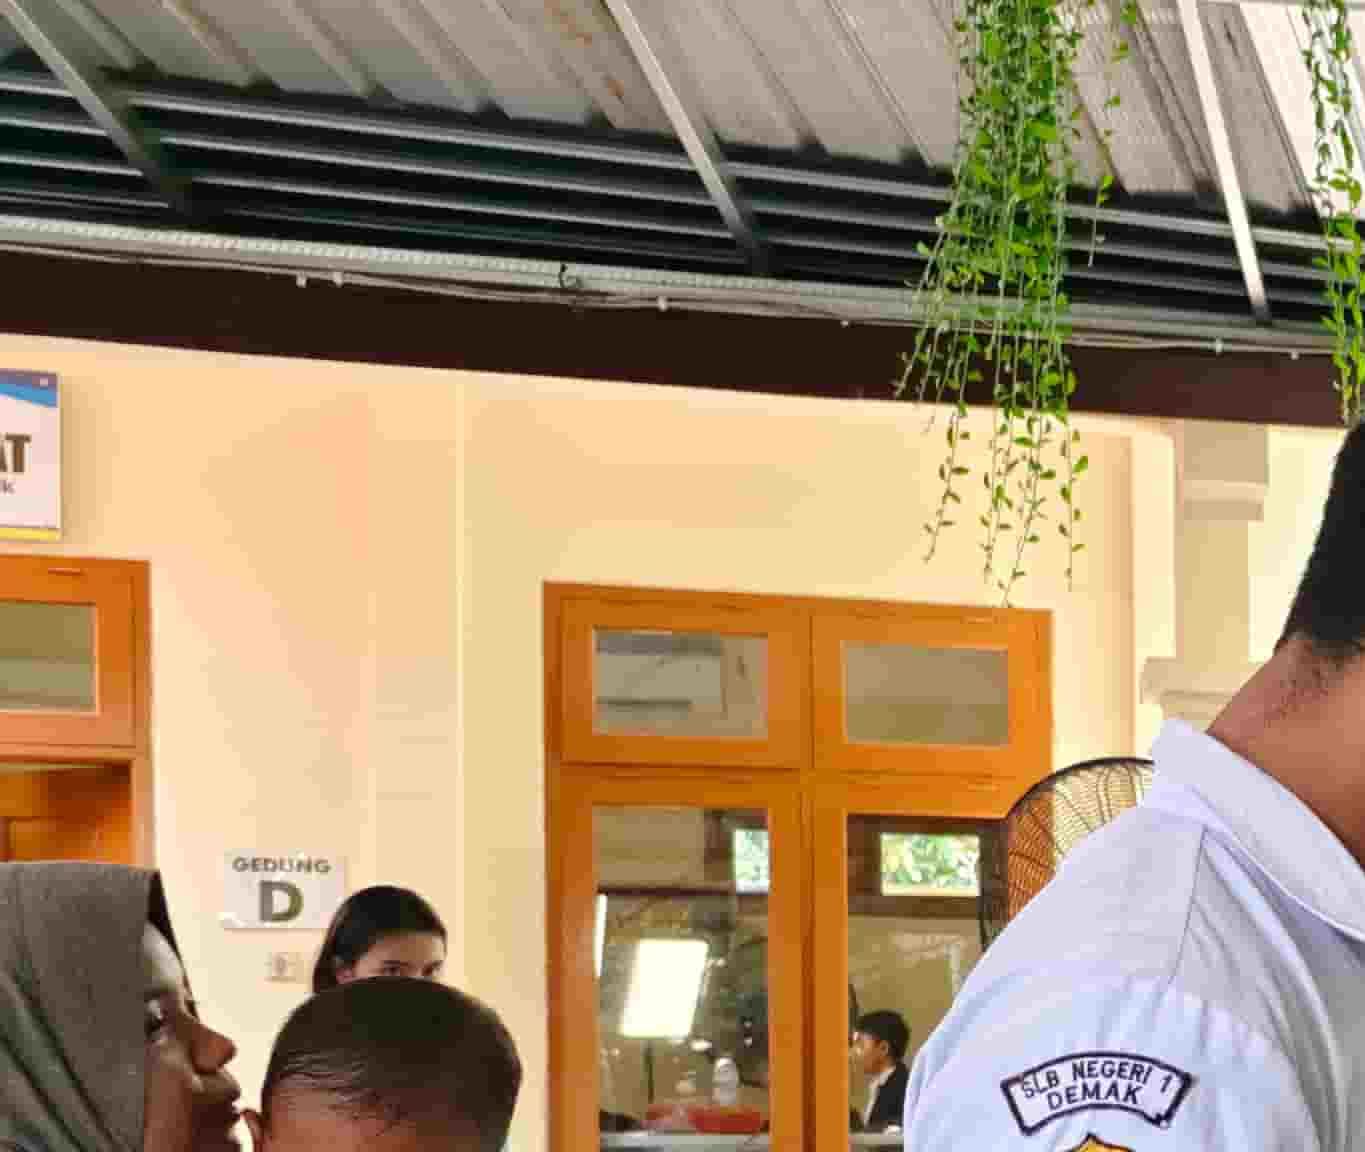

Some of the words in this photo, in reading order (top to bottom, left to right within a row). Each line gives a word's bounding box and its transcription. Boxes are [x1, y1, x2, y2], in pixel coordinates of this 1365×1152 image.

[232, 856, 331, 873] GEDUNG
[259, 880, 304, 922] D
[1020, 1069, 1060, 1099] SLB
[1071, 1060, 1153, 1085] NEGERI
[1159, 1075, 1174, 1093] 1
[1048, 1081, 1143, 1111] DEMAK
